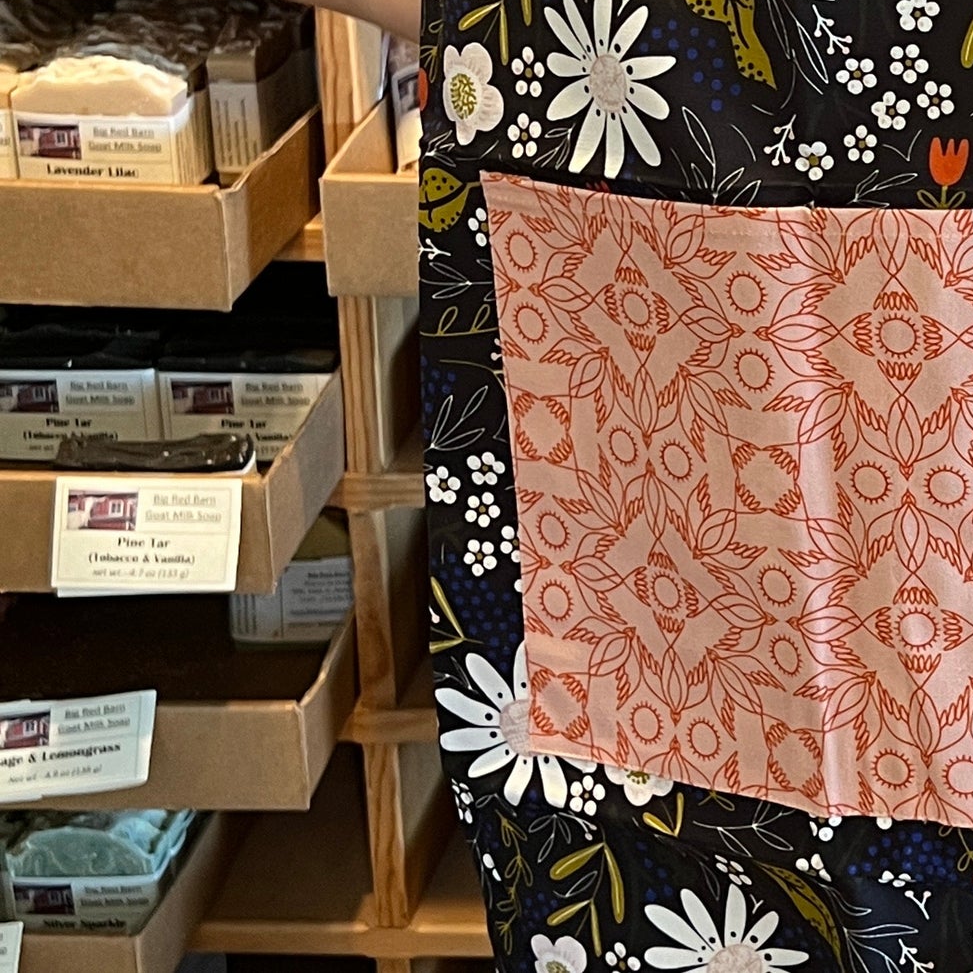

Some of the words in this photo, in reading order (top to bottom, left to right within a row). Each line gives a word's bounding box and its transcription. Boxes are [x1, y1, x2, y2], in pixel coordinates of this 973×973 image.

[47, 163, 104, 177] Lavender
[108, 166, 138, 178] Lilac
[46, 418, 69, 427] Pine
[221, 419, 244, 428] Pine
[153, 494, 169, 506] Big
[171, 494, 191, 505] Red
[193, 495, 216, 506] Barn
[145, 510, 169, 521] Goat
[173, 511, 194, 521] Milk
[197, 511, 222, 523] Soap
[118, 536, 145, 548] Pine
[150, 537, 171, 548] Tar
[88, 552, 139, 564] (Tobacco
[142, 554, 151, 563] &
[154, 554, 196, 565] Vanilla)
[0, 757, 23, 767] age
[28, 754, 36, 763] &
[42, 744, 121, 761] Lemongrass
